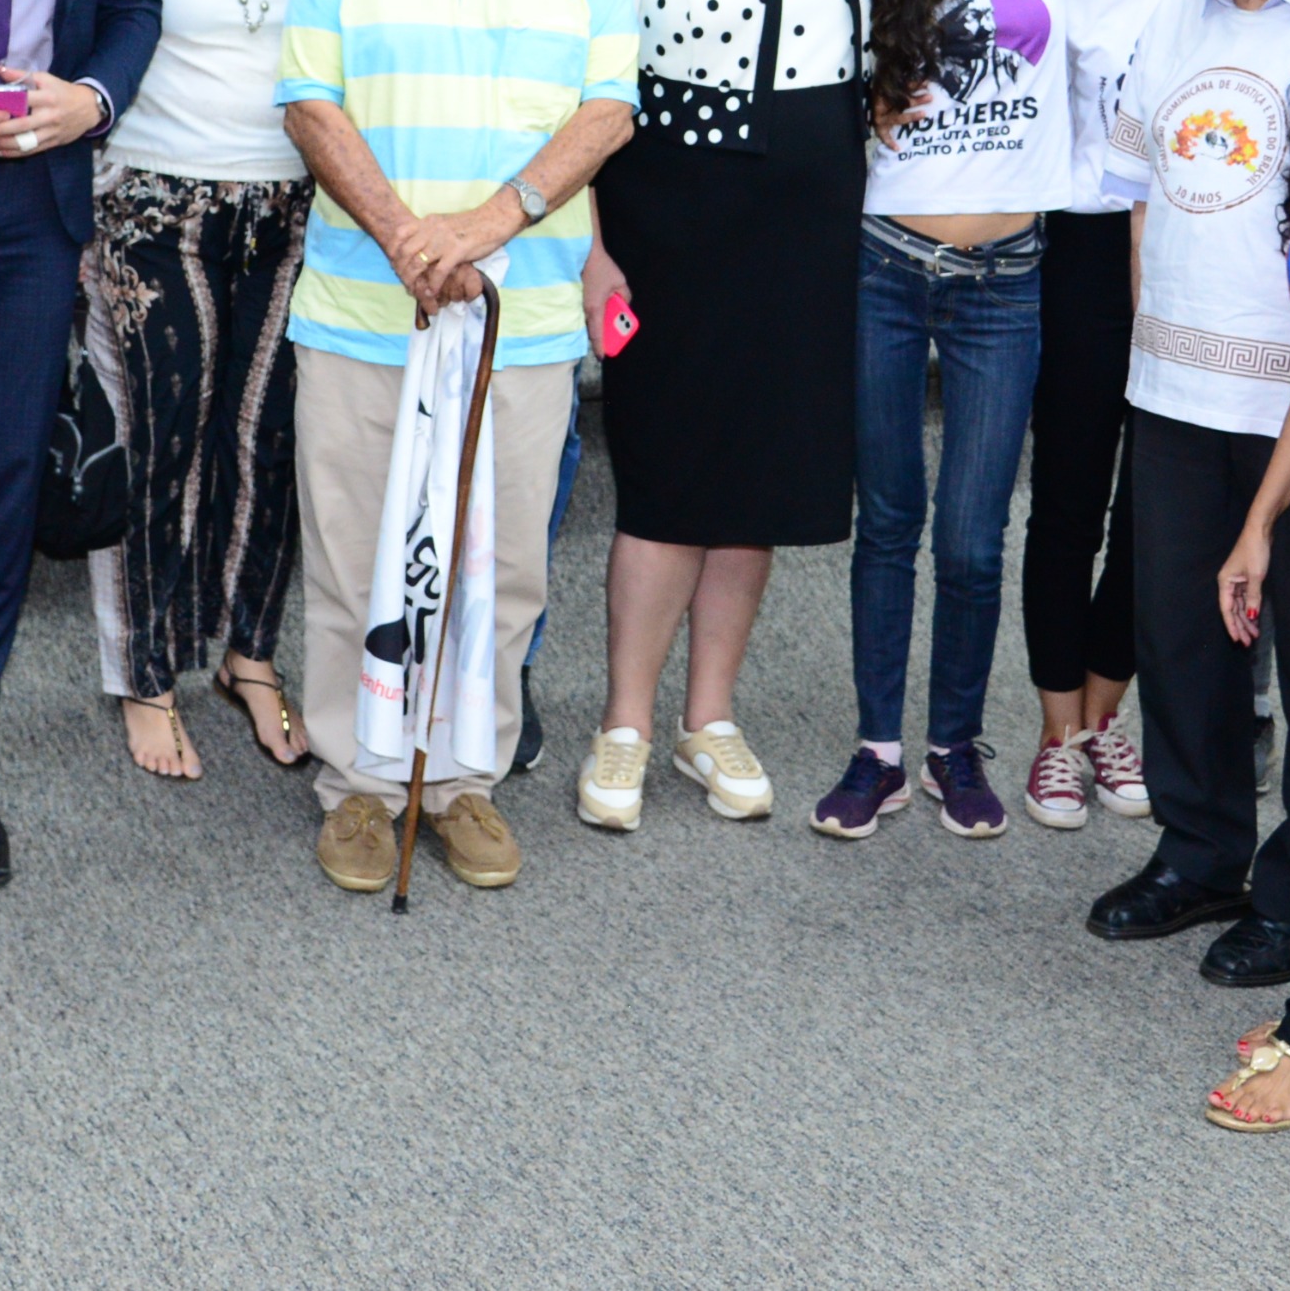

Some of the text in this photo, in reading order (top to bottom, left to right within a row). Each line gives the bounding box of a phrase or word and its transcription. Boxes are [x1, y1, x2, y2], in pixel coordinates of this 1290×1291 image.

[1218, 79, 1232, 90] DE
[1162, 80, 1214, 122] DOMINICANA
[1234, 82, 1267, 106] JUSTIÇA
[1263, 105, 1273, 113] E
[1266, 114, 1278, 132] PAZ
[912, 135, 934, 147] EM
[977, 125, 1011, 138] PELO
[1266, 137, 1278, 151] DO
[972, 139, 1024, 152] CIDADE
[1246, 154, 1273, 186] BRASIL
[1190, 191, 1222, 204] ANOS
